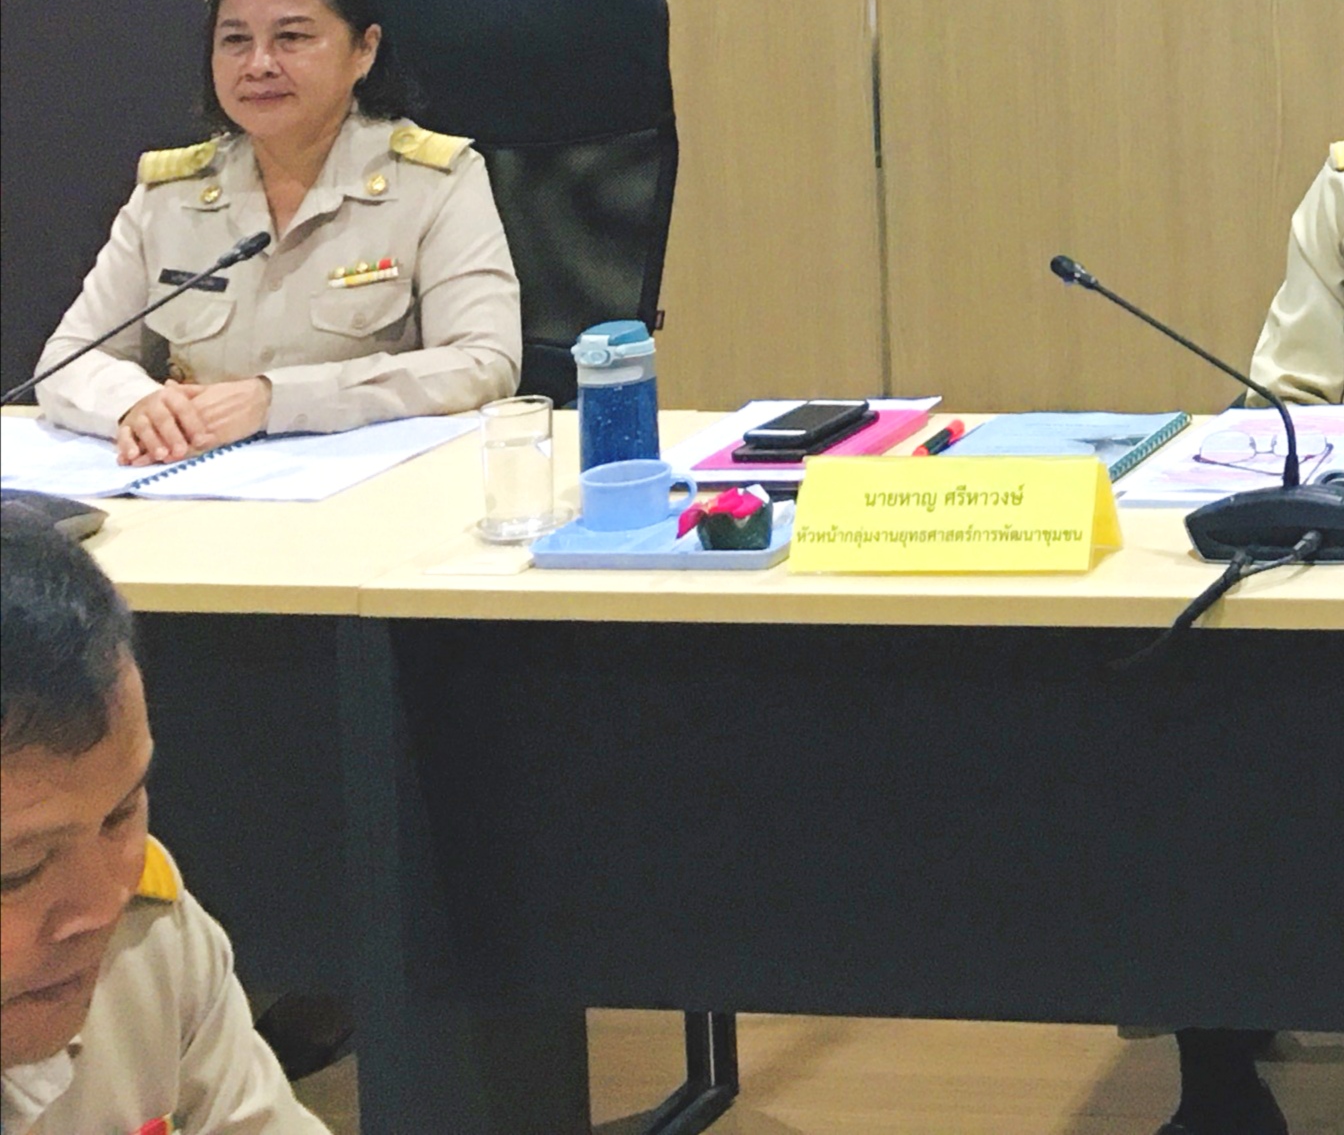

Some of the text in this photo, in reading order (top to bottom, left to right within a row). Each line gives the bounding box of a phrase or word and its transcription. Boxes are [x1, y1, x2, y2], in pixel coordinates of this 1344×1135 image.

[864, 484, 1025, 512] นายหาญ ศรีหาวงษ์
[796, 524, 1083, 547] หัวหน้ากลุ่มงานยุทธศาสตร์การพัฒนาชุมชน
